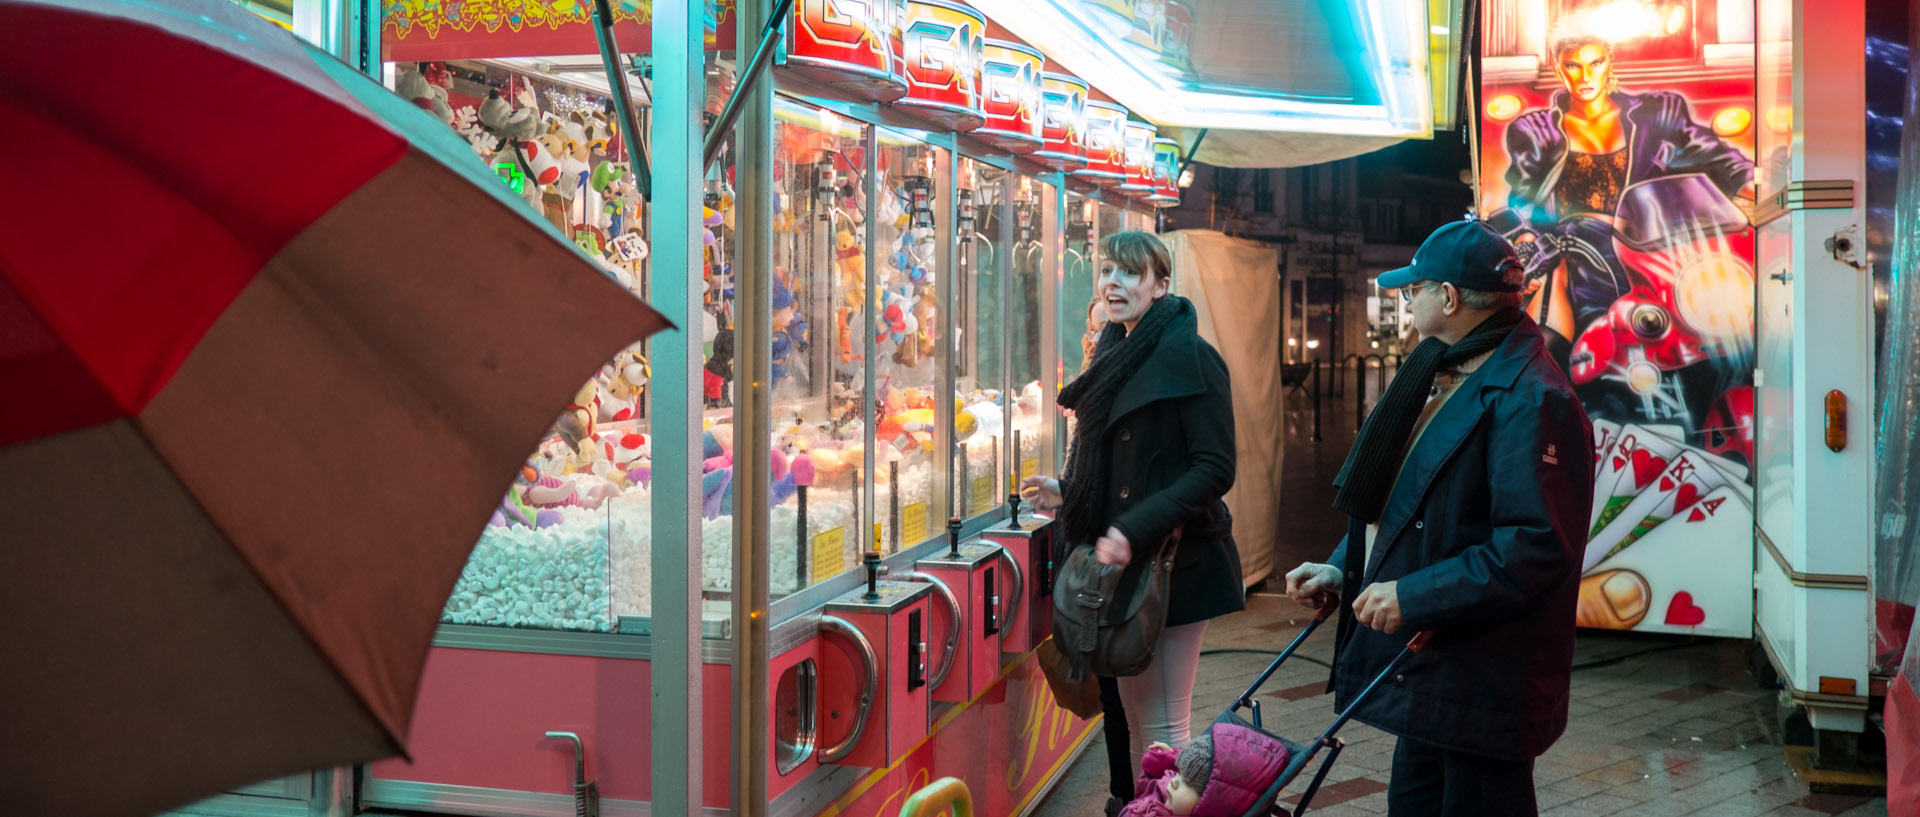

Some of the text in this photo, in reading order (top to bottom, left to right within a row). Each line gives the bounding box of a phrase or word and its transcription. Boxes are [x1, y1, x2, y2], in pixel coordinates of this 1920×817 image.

[1042, 91, 1088, 145] GI
[1595, 427, 1609, 450] J
[1619, 434, 1637, 461] Q
[1669, 456, 1695, 483] K
[1702, 497, 1727, 516] A
